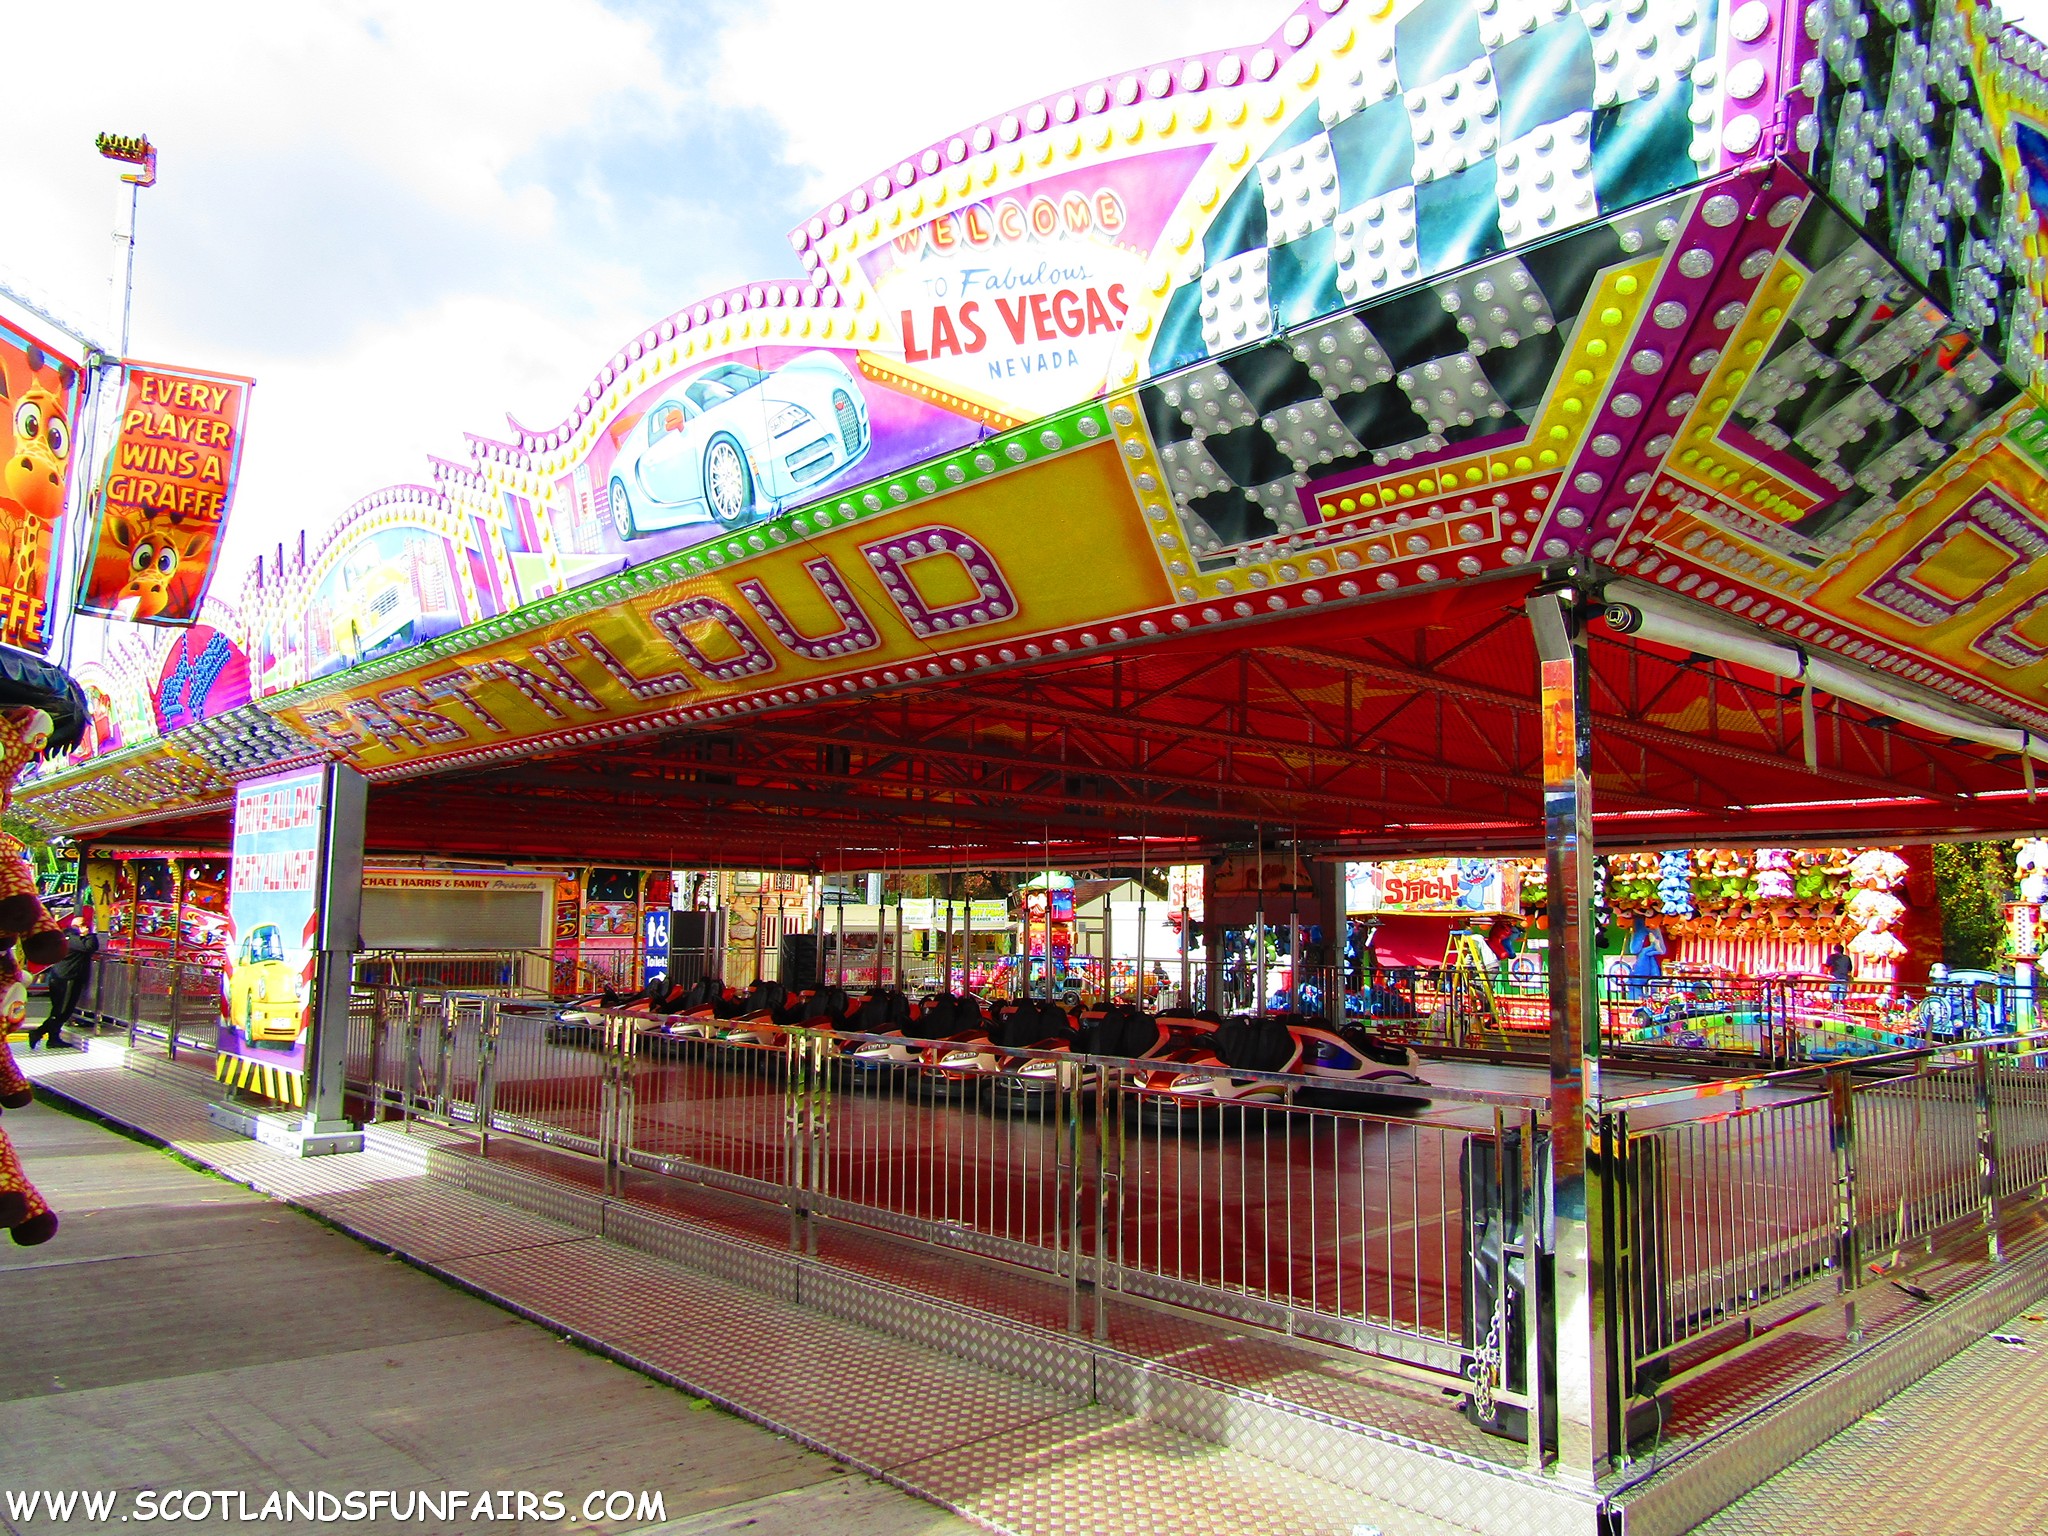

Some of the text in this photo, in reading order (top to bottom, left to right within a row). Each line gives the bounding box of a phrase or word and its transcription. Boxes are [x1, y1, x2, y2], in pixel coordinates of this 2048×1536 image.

[899, 196, 1121, 254] WELCOME
[922, 261, 1094, 298] TO Fabulous
[900, 283, 1130, 364] LAS VEGAS
[989, 349, 1080, 379] NEVADA
[141, 376, 230, 414] EVERY
[124, 409, 231, 449] PLAYER
[122, 442, 224, 486] WINS A
[106, 475, 228, 522] GIRAFFE
[303, 669, 505, 761] FAST
[574, 524, 1019, 701] LOUD
[237, 785, 319, 834] DRIVE ALL DAY
[234, 850, 315, 891] PARTY ALL NIGHT
[401, 877, 442, 888] HARRIS
[444, 879, 451, 888] &
[453, 879, 490, 889] FAMILY
[1384, 874, 1459, 904] Stitch!
[646, 955, 668, 968] Toilets
